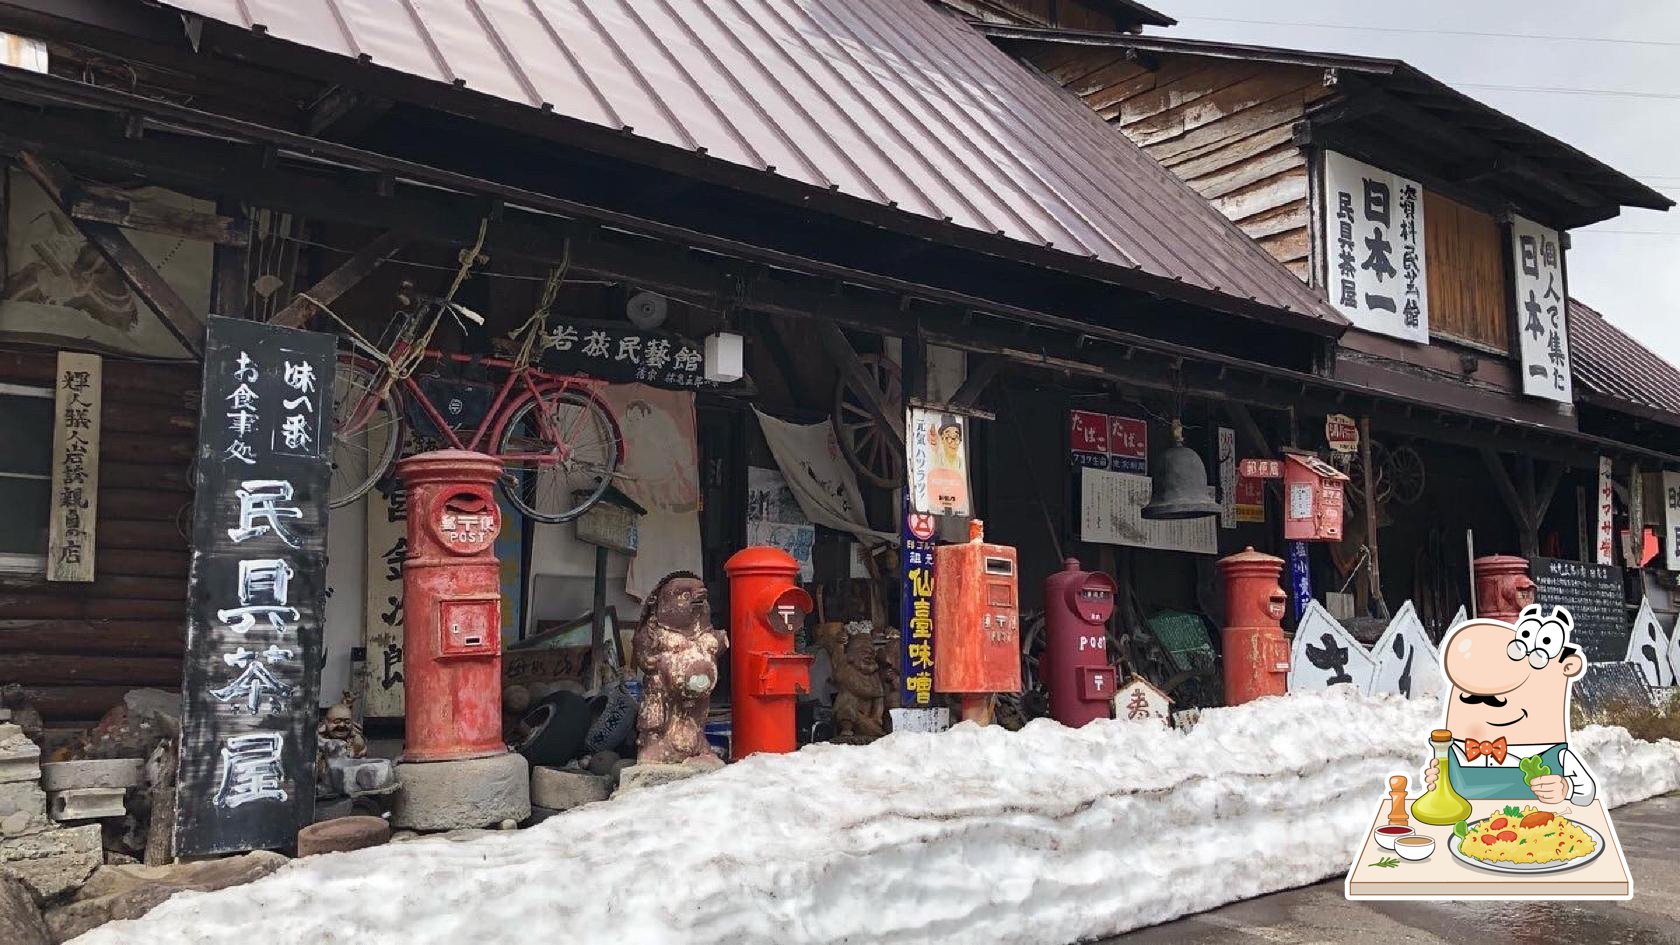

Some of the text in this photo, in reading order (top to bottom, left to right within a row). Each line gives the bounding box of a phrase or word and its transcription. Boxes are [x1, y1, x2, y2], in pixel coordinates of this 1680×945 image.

[1337, 191, 1358, 309] 民具茶屋
[1361, 177, 1397, 314] 日本一
[1520, 234, 1548, 380] 日本一
[222, 350, 261, 465] お食事処
[450, 532, 485, 543] POST
[209, 479, 302, 809] 民具茶屋
